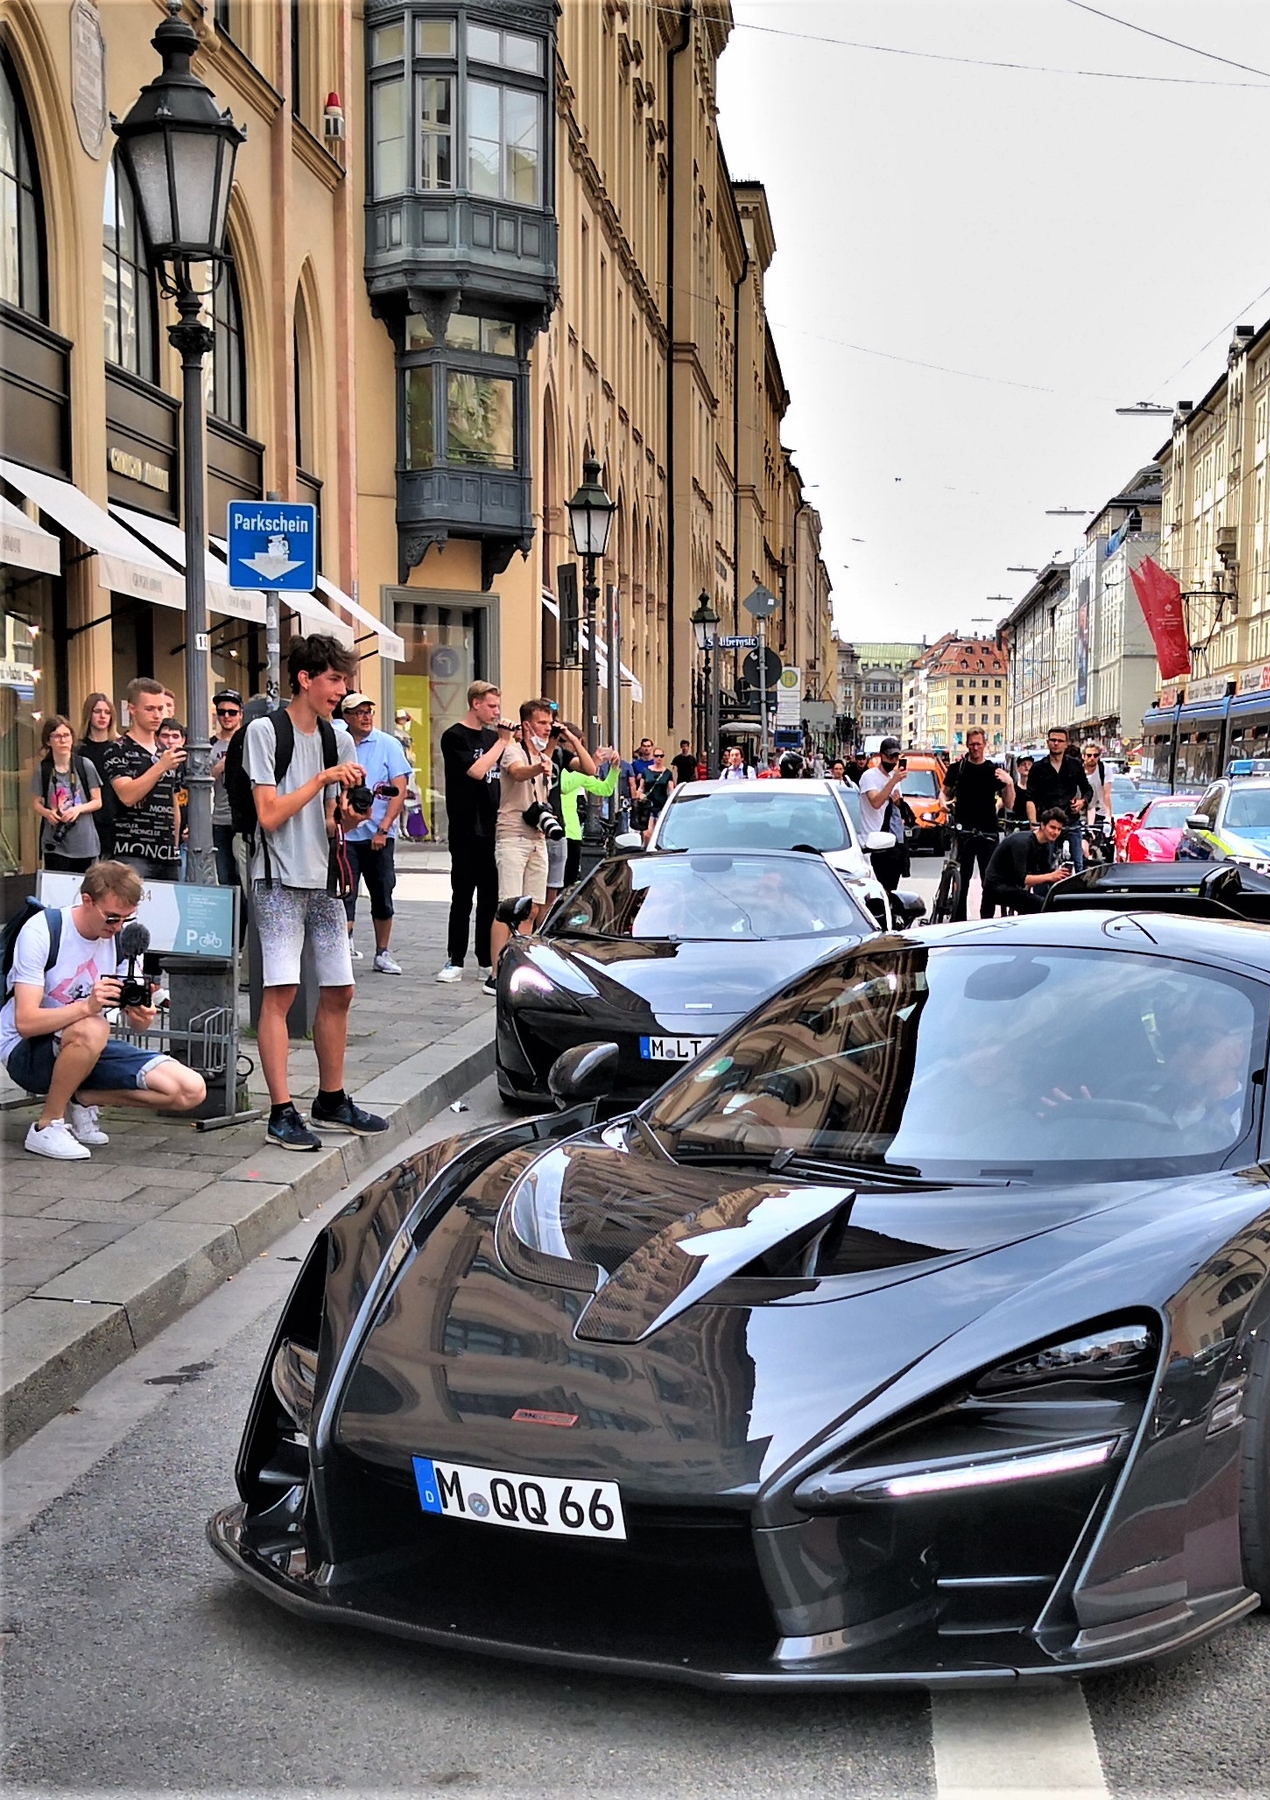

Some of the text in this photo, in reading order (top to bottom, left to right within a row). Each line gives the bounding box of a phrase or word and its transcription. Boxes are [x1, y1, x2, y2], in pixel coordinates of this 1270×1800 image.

[234, 512, 309, 533] Parkschein
[651, 1039, 664, 1057] M
[435, 1467, 466, 1513] M
[489, 1478, 549, 1526] QQ
[559, 1486, 615, 1532] 66
